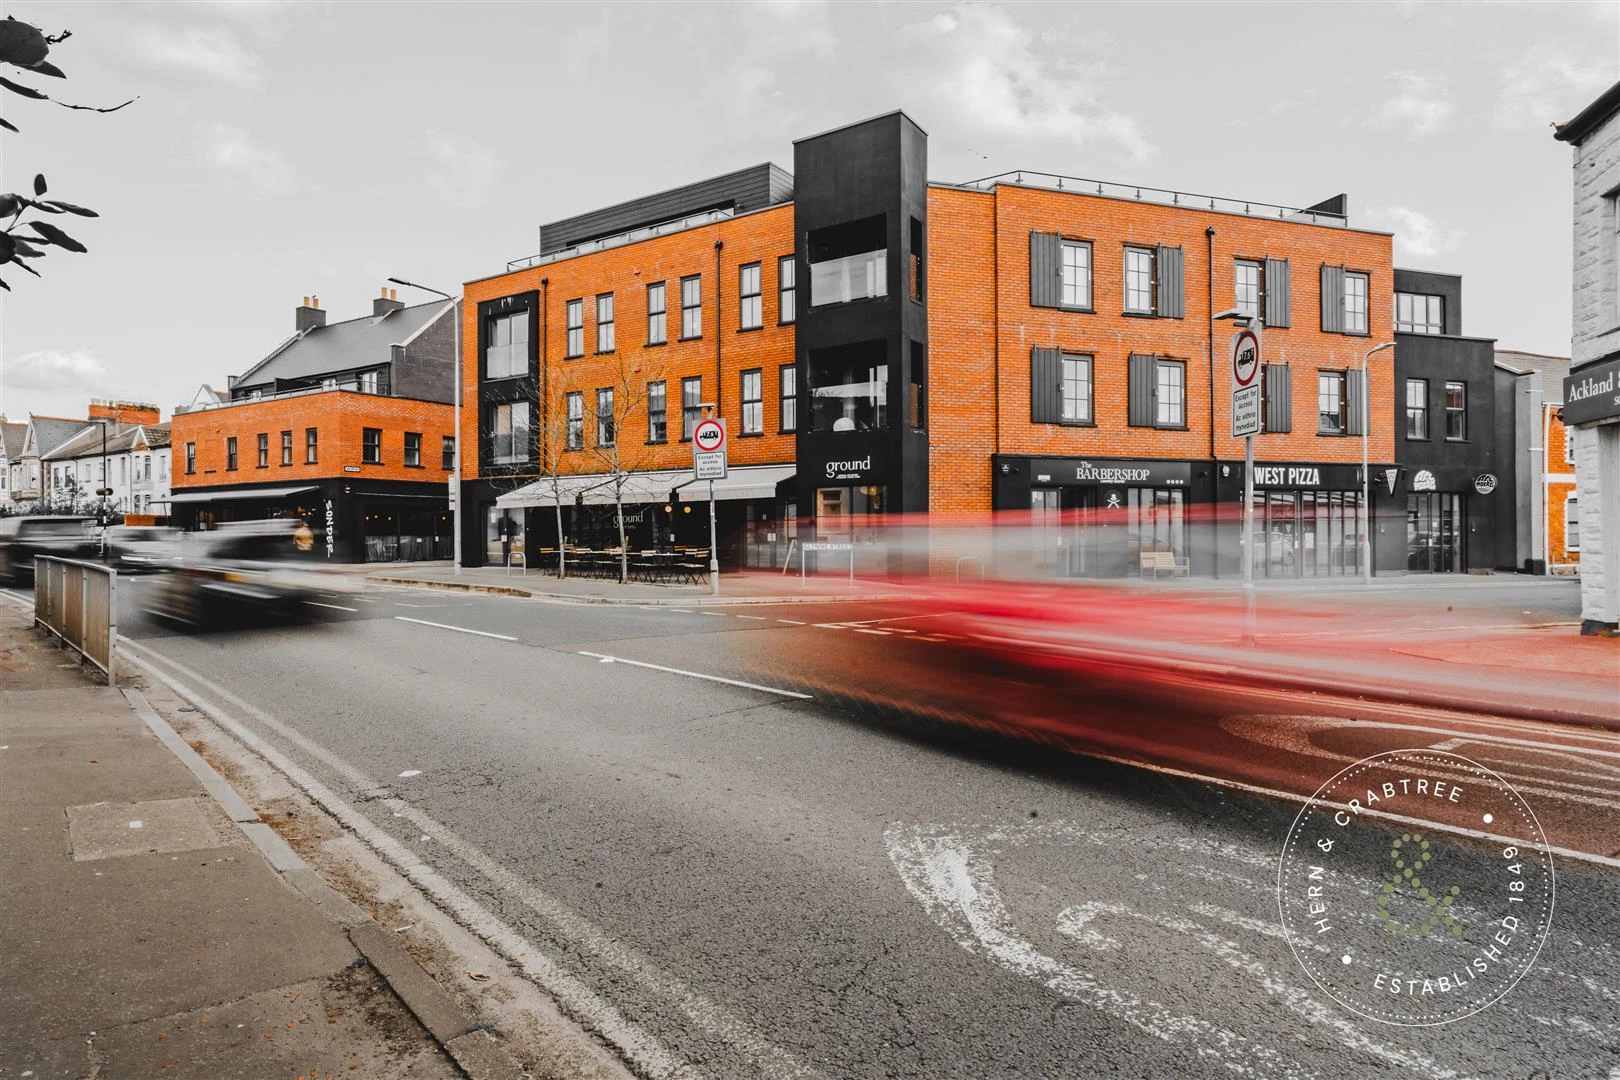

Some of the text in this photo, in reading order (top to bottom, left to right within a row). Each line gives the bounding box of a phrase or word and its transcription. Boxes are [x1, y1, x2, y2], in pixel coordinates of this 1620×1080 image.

[1568, 371, 1614, 403] Ackland
[1235, 392, 1249, 402] Except
[1238, 401, 1253, 409] access
[825, 455, 871, 478] ground
[1080, 461, 1093, 469] The
[1076, 467, 1151, 481] BARBERSHOP
[1253, 467, 1320, 485] WEST PIZZA
[612, 511, 644, 528] gound
[325, 499, 334, 558] SONDER
